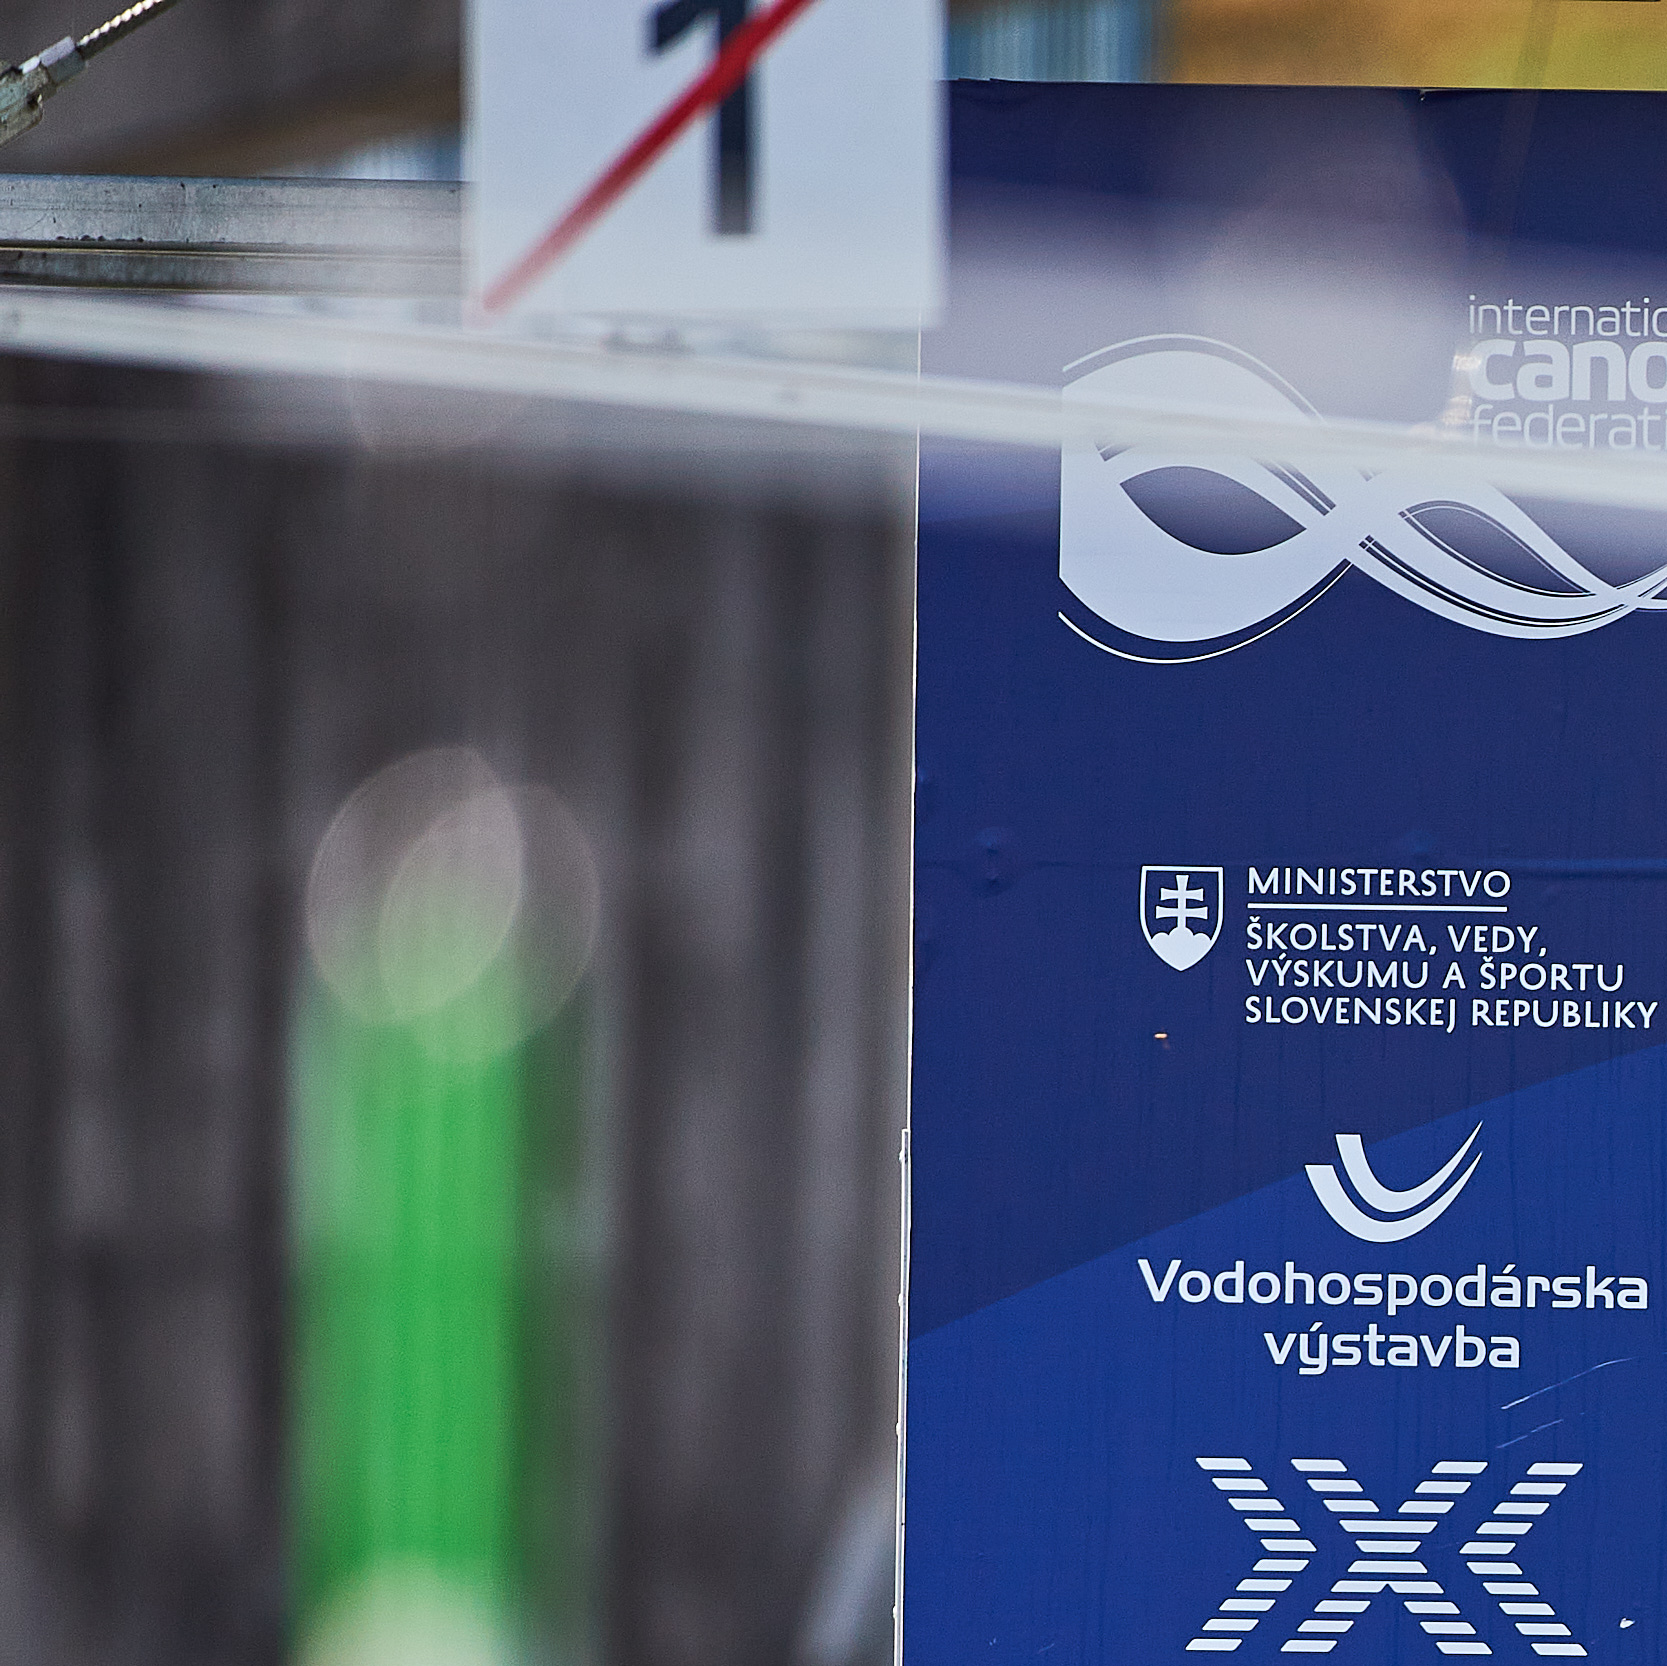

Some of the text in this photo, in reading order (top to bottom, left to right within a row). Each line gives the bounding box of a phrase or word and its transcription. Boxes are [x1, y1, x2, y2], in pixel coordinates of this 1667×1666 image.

[1248, 866, 1511, 898] MINISTERSTVO
[1246, 915, 1547, 960] ŠKOLSTVA, VEDY,
[1245, 952, 1624, 992] VÝSKUMU A ŠPORTU
[1245, 995, 1658, 1034] SLOVENSKEJ REPUBLIKY
[1137, 1258, 1648, 1316] Vodohospodárska
[1263, 1321, 1520, 1375] výstavba
